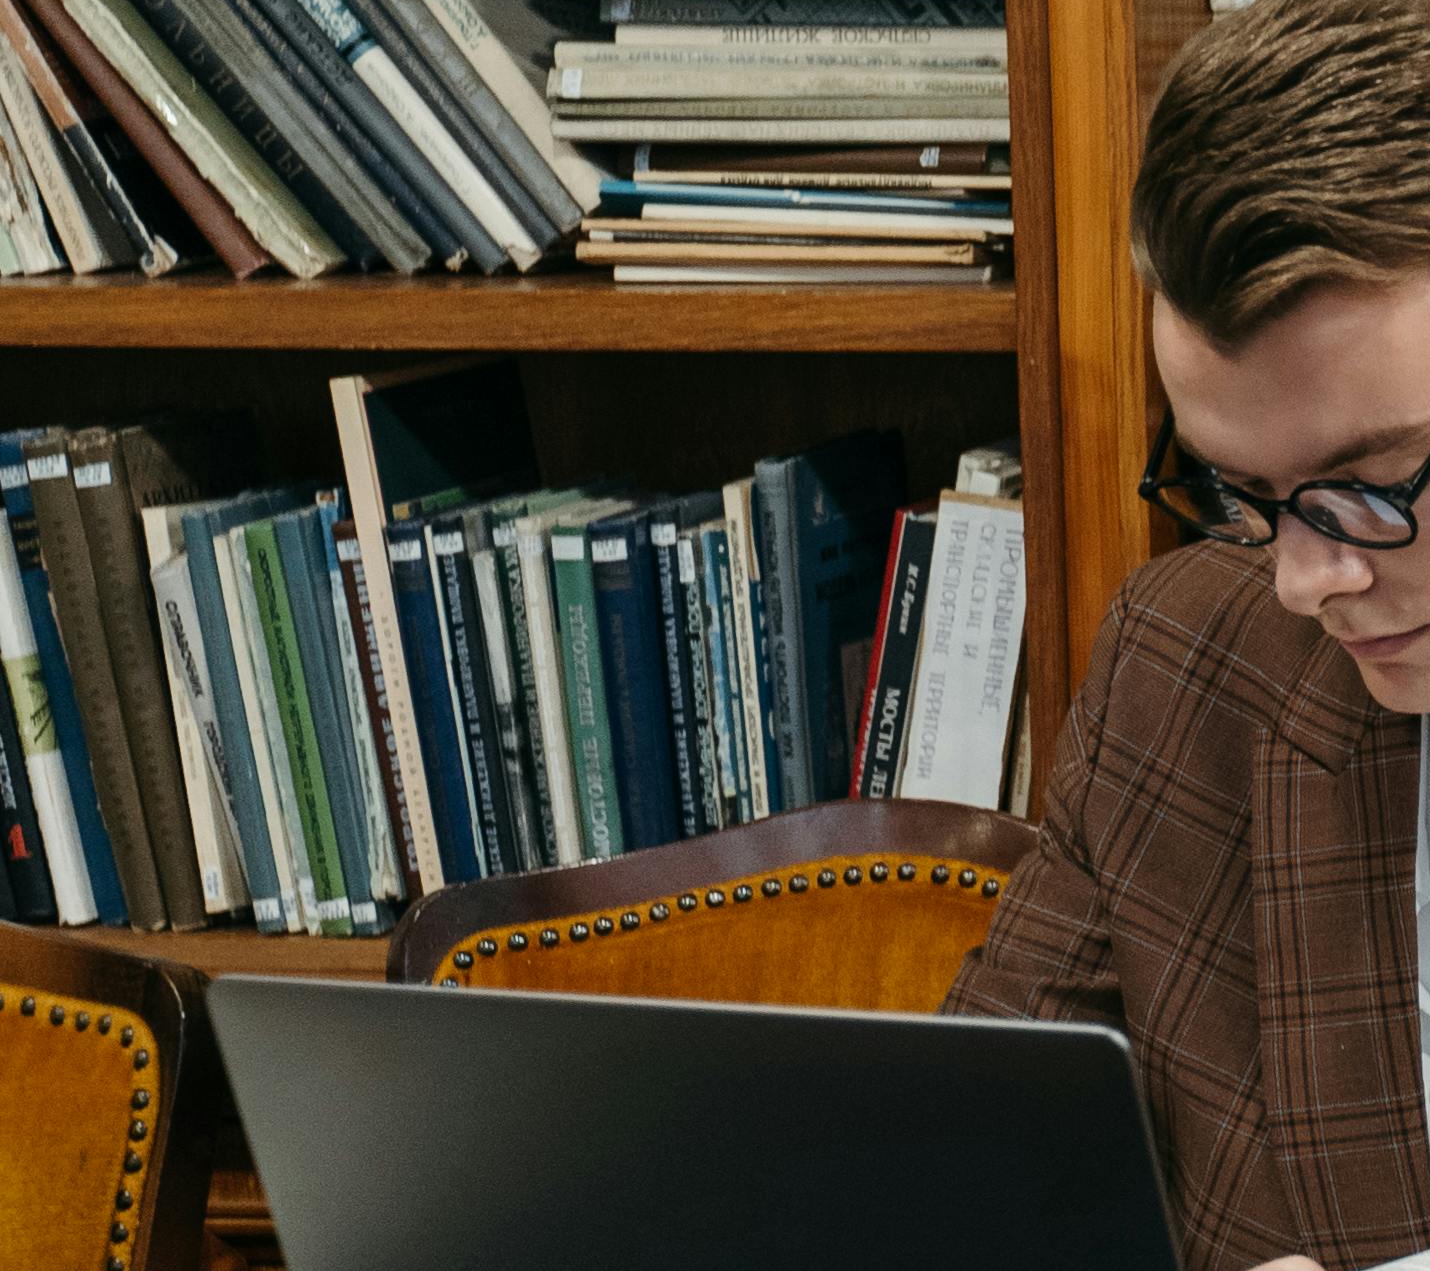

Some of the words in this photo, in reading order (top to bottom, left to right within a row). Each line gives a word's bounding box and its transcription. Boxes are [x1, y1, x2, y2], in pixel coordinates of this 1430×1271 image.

[719, 26, 820, 43] ЖИЛИЩЕ
[830, 27, 931, 44] СЕЛЬСКОЕ
[931, 517, 970, 657] ТРАНСПОРТНЫЕ
[348, 557, 389, 709] ДВИЖЕНИ
[874, 686, 901, 762] МОСТЫ
